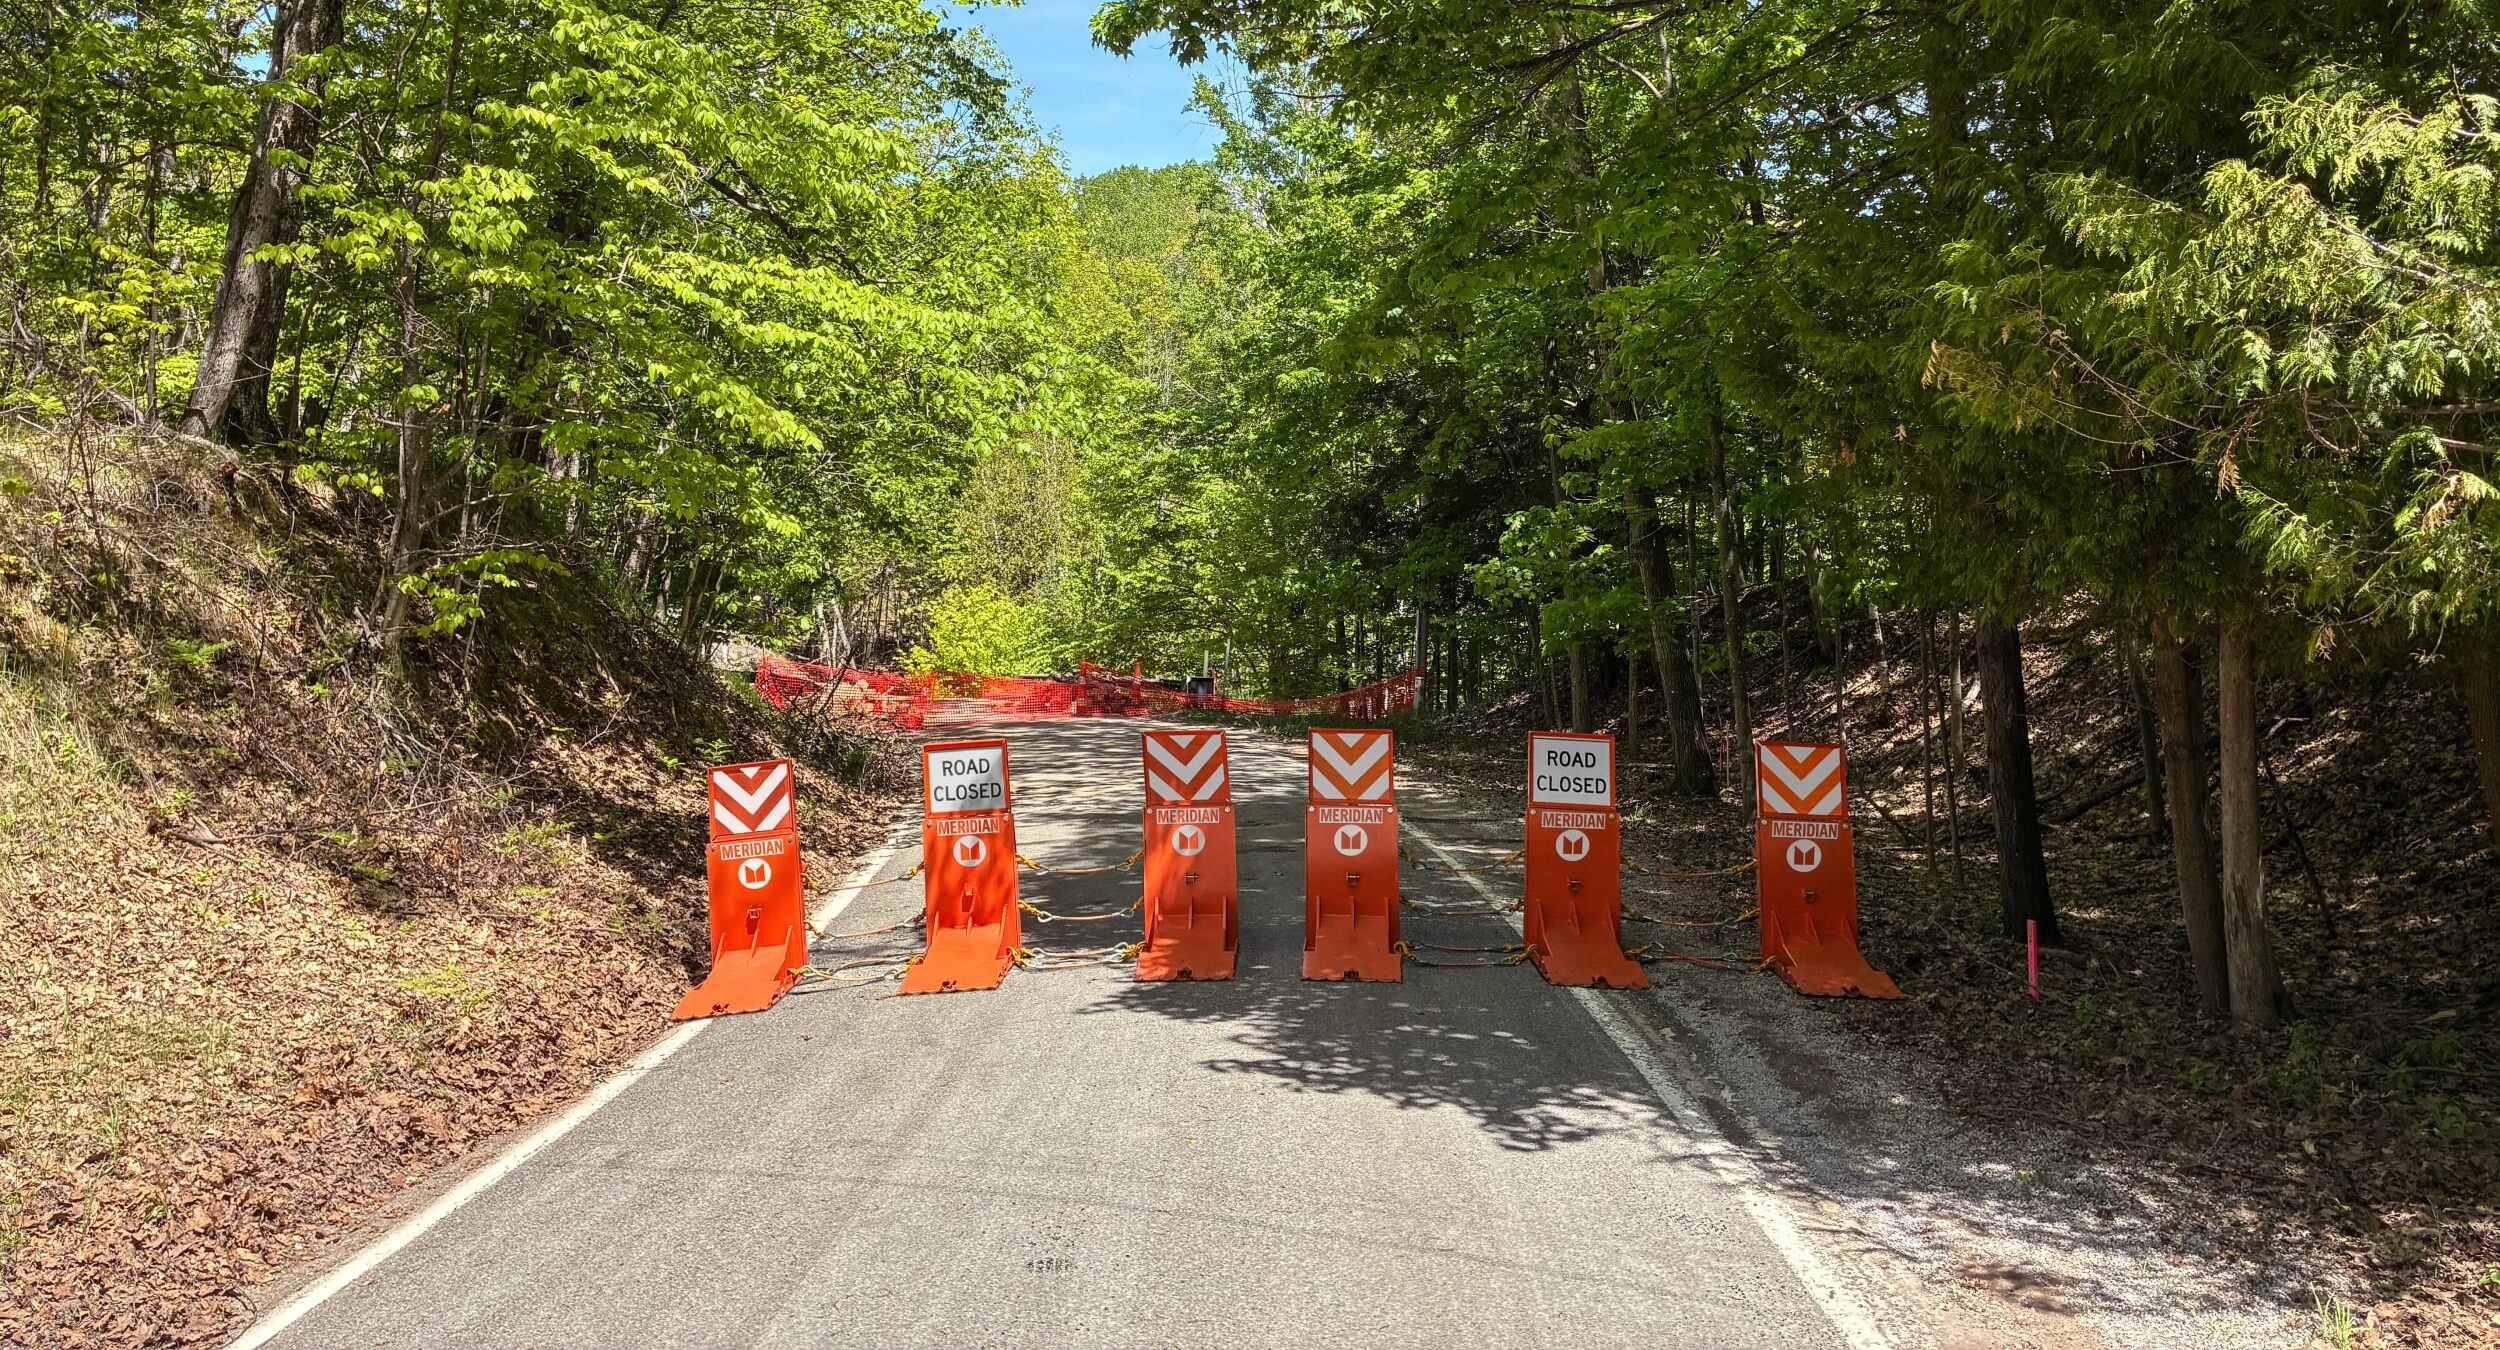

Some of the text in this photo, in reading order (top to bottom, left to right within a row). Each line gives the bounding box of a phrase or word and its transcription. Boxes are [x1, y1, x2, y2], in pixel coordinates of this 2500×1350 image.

[942, 758, 990, 776] ROAD
[1547, 750, 1596, 768] ROAD
[933, 782, 1001, 802] CLOSED
[1536, 775, 1607, 794] CLOSED
[1158, 809, 1219, 824] MERIDIAN
[1320, 808, 1381, 823] MERIDIAN
[1543, 812, 1604, 829] MERIDIAN
[938, 818, 999, 835] MERIDIAN
[1773, 822, 1838, 838] MERIDIAN
[722, 839, 783, 859] MERIDIAN
